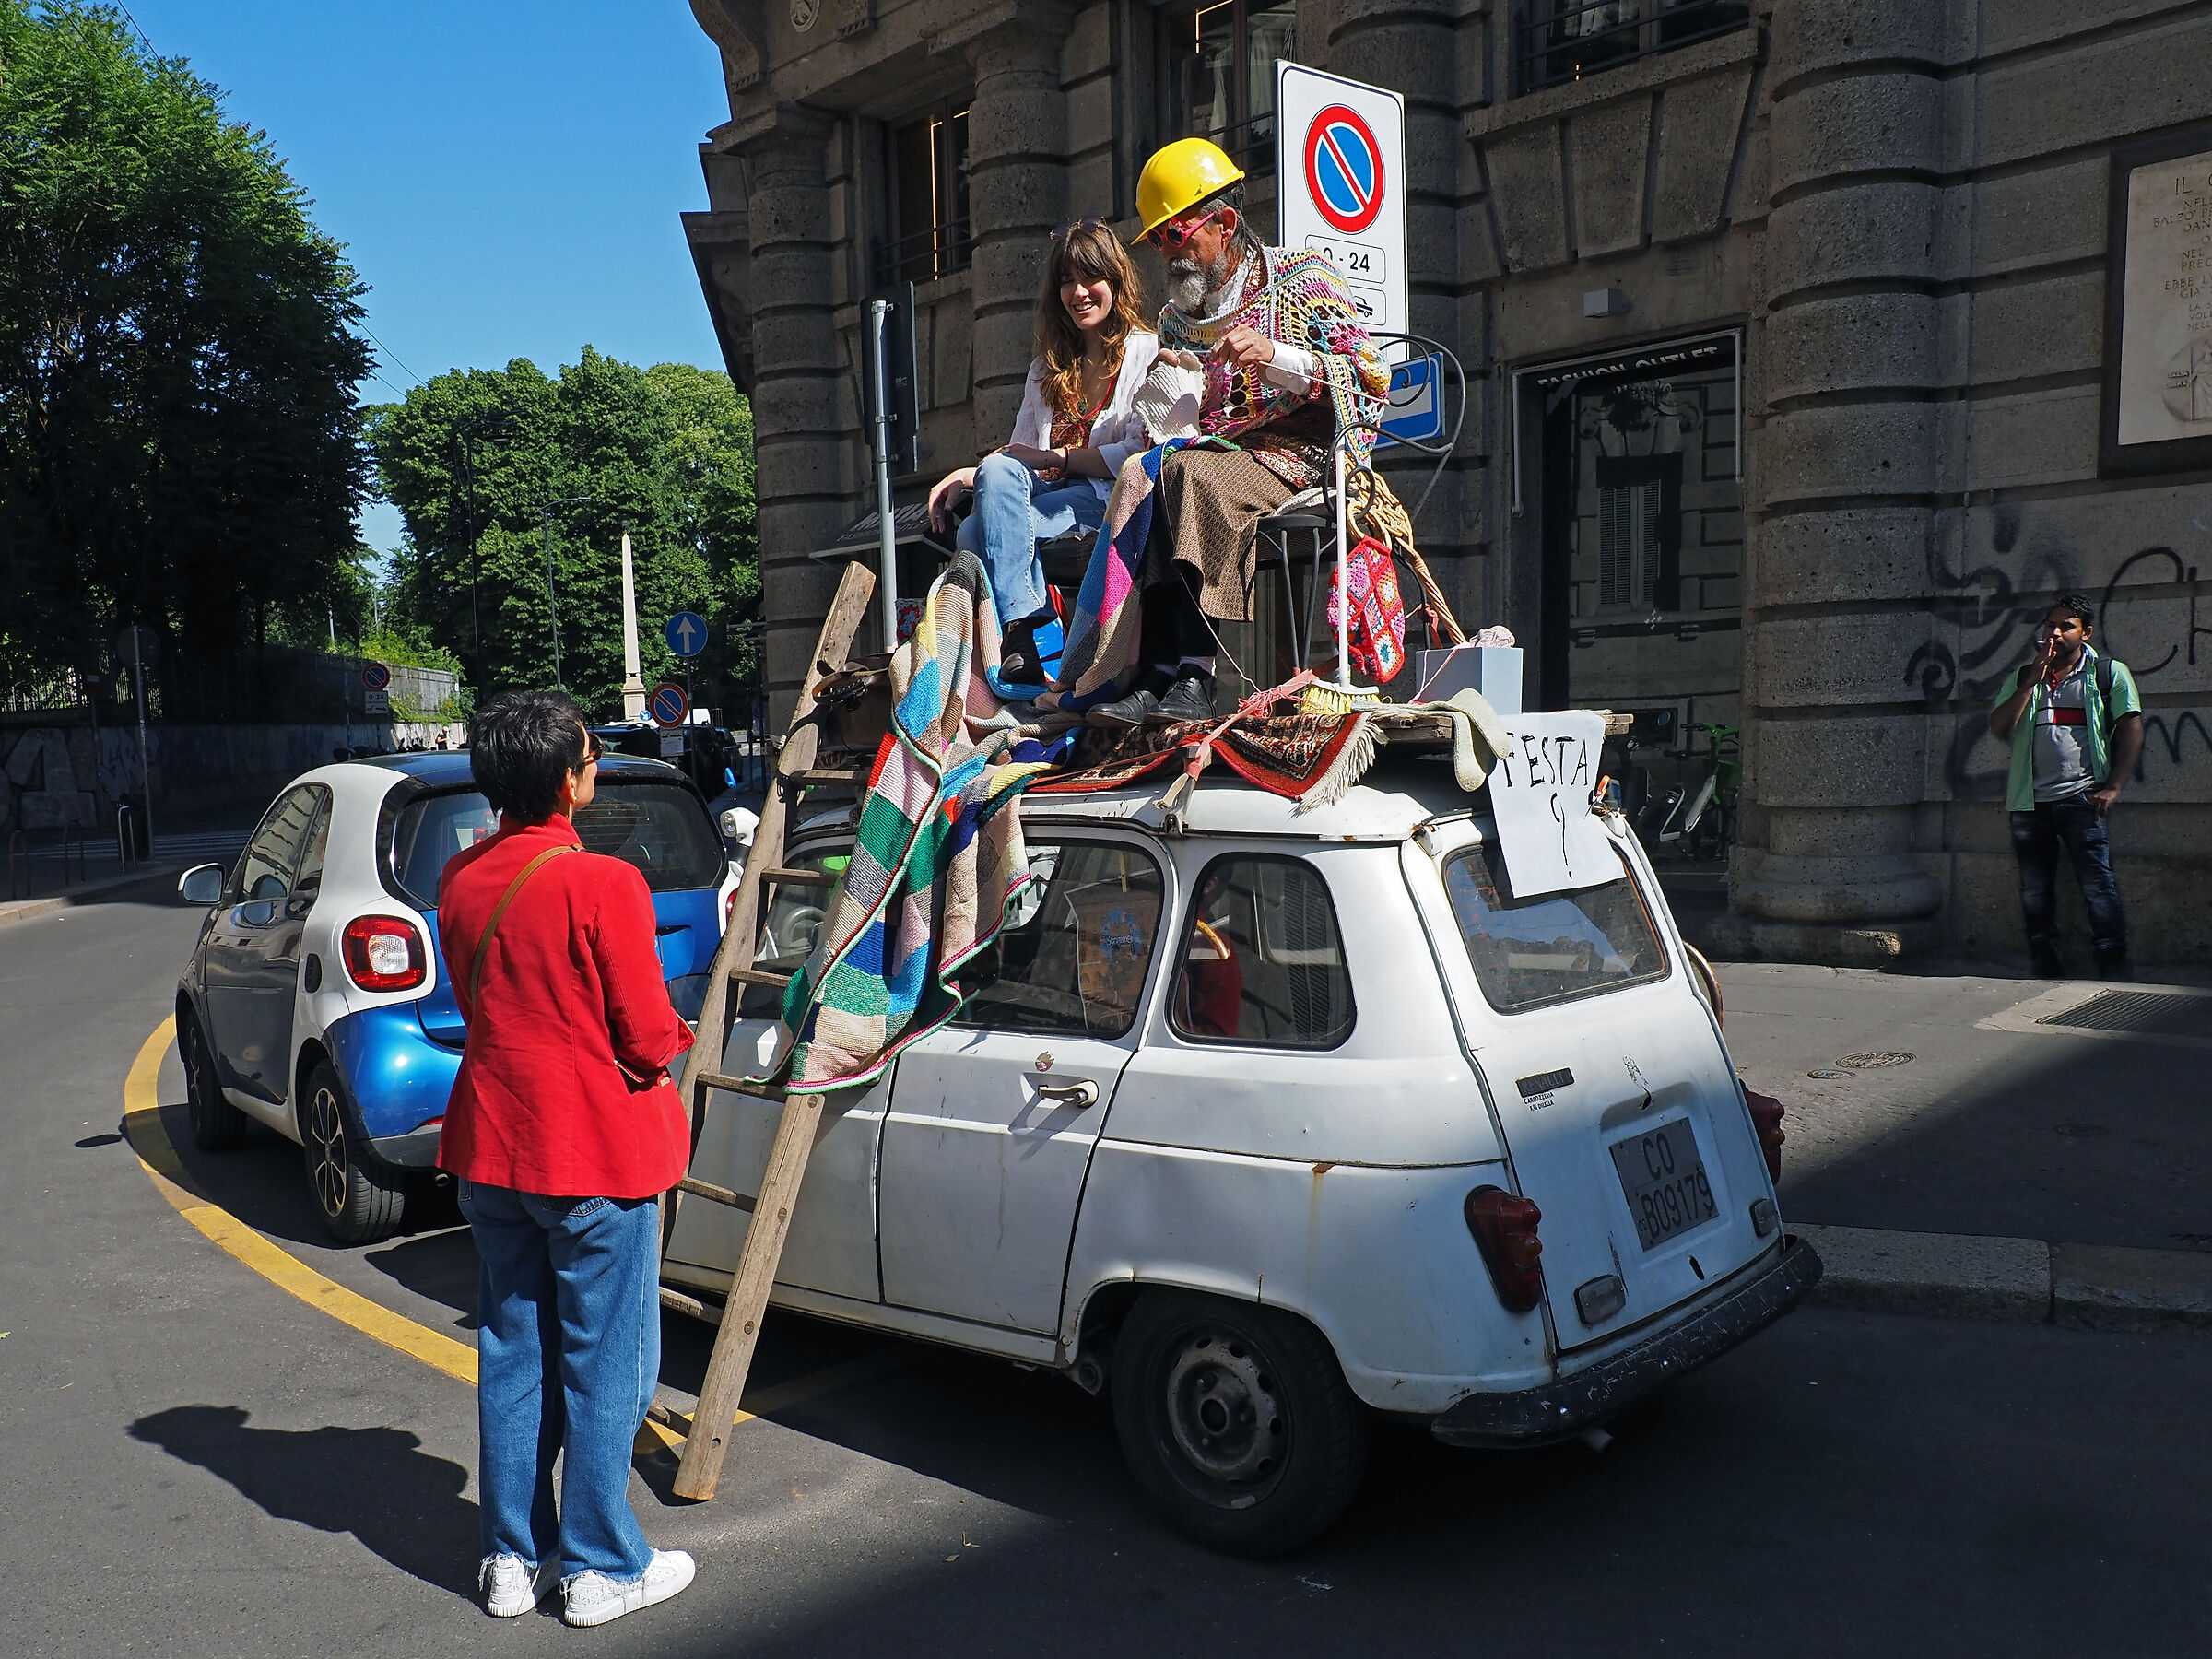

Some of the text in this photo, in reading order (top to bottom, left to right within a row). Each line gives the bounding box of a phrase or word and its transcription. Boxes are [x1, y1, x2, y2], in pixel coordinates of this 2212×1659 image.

[1349, 252, 1371, 273] 24
[1642, 1132, 1675, 1180] CO
[1641, 1170, 1714, 1238] B09179
